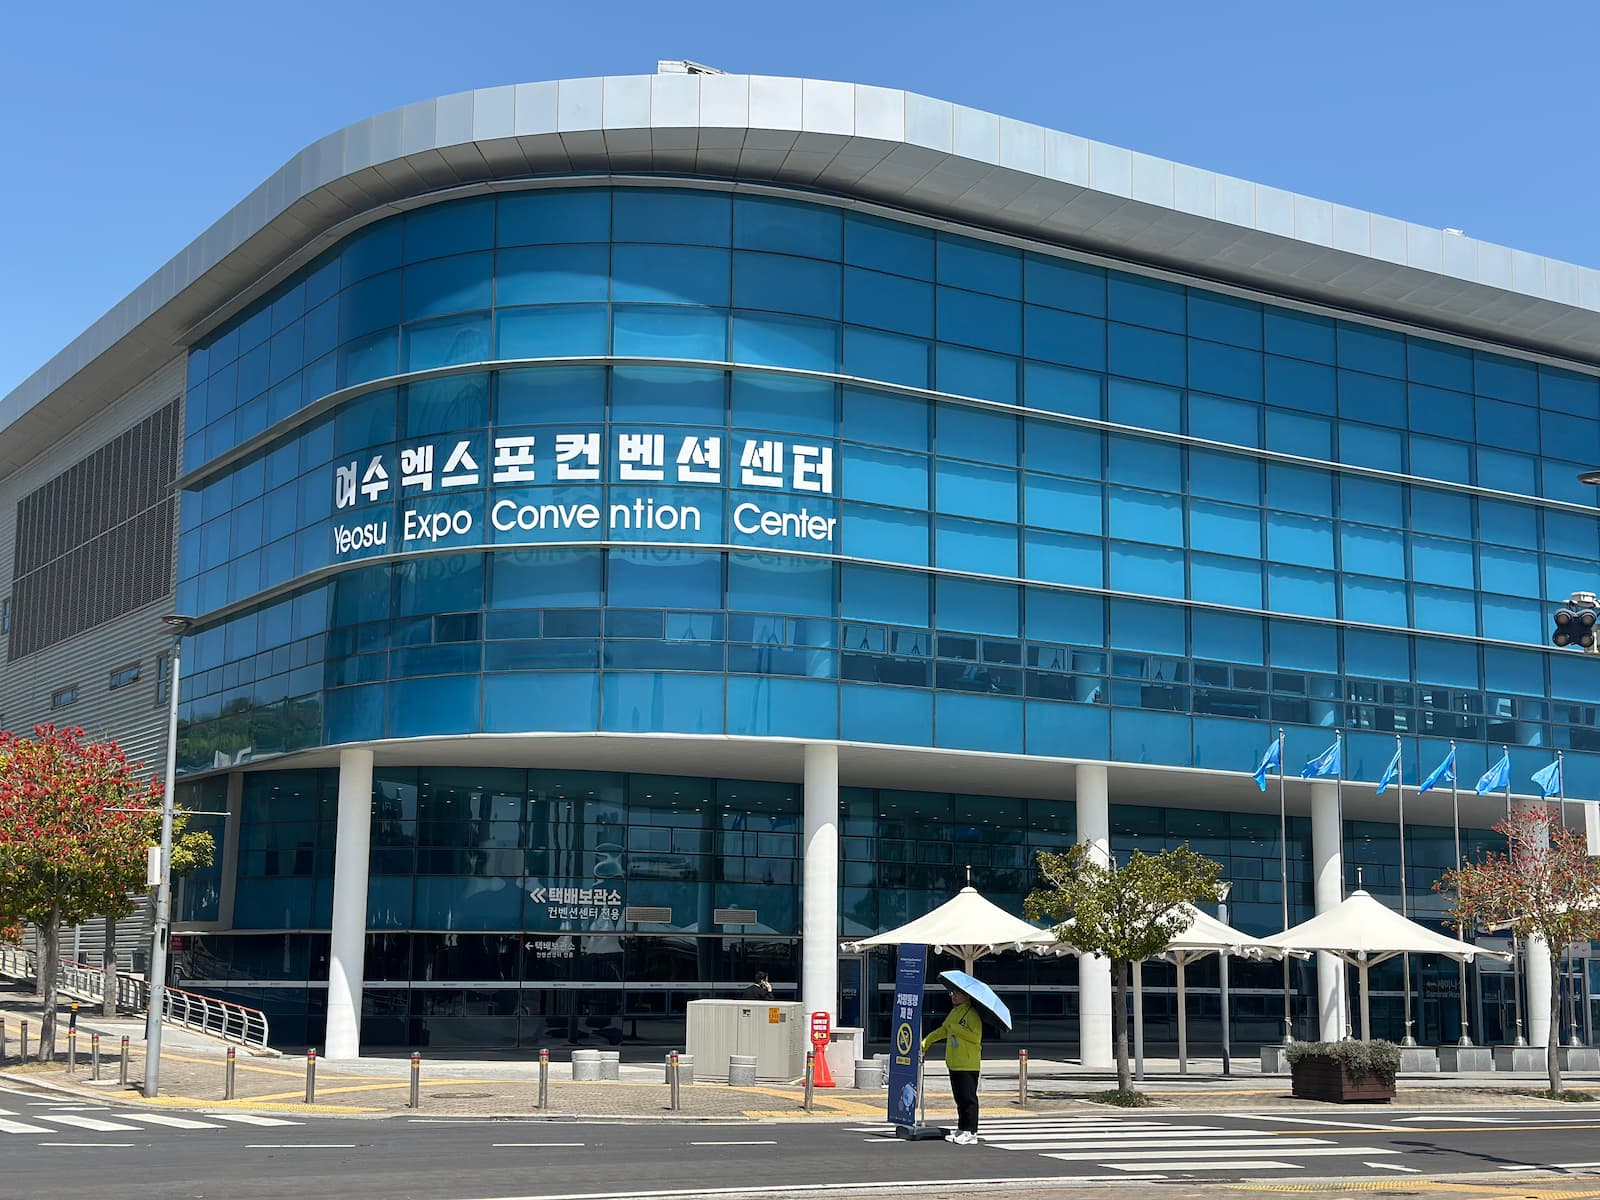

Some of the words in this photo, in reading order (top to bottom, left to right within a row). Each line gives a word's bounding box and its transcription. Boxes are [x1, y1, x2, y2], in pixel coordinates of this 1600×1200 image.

[334, 521, 387, 554] Yeosu
[403, 509, 472, 542] Expo
[734, 502, 836, 541] Center
[548, 887, 621, 906] 택배보관소
[547, 906, 599, 919] 컨벤션센터
[600, 907, 620, 921] 전용
